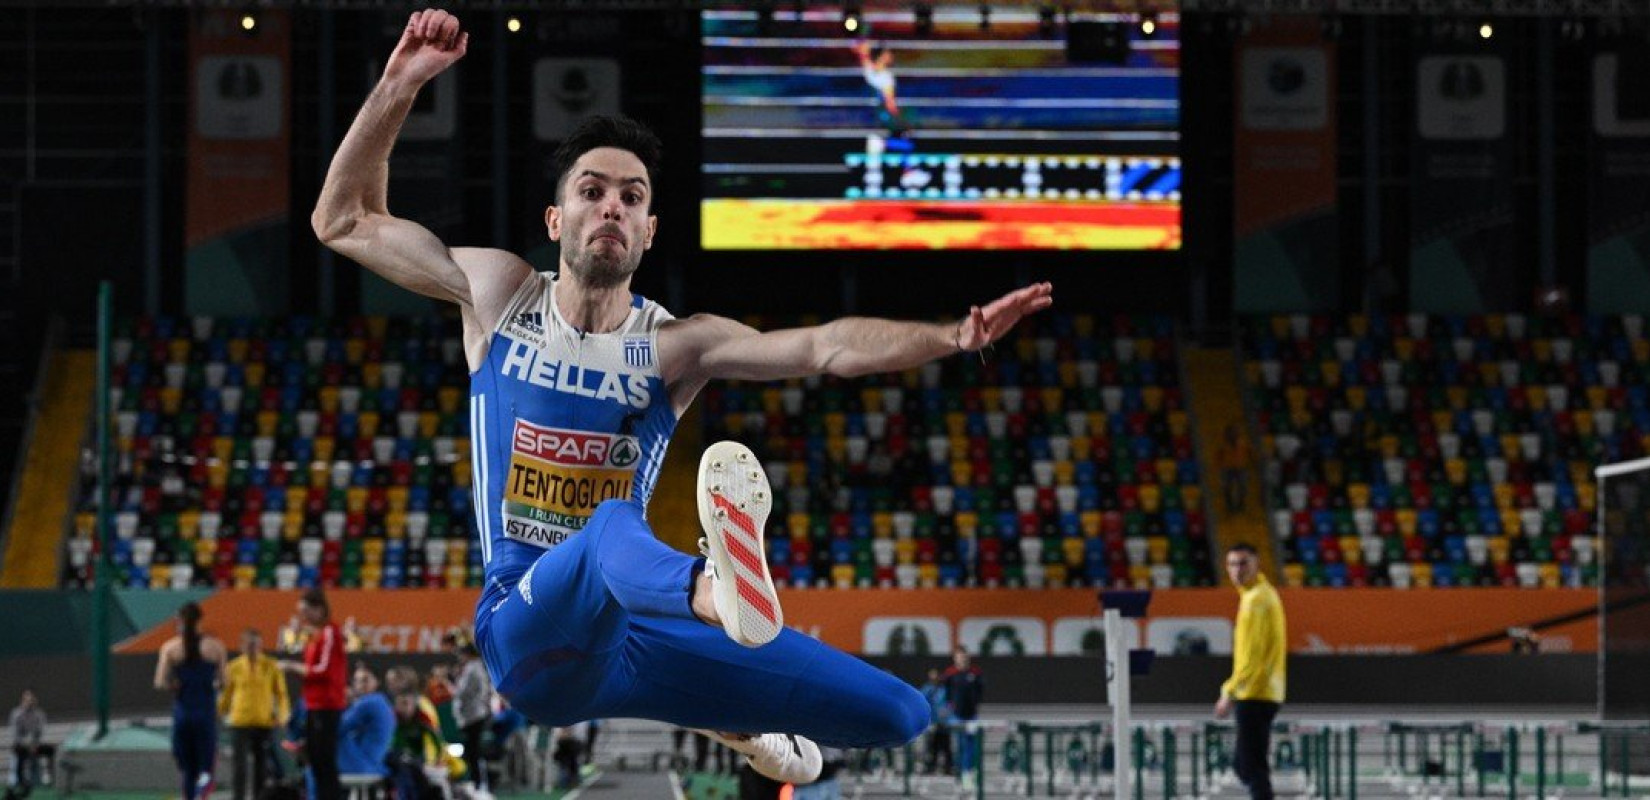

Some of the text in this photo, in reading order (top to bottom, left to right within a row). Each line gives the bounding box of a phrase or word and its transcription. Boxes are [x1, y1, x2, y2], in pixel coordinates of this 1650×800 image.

[501, 339, 651, 409] HELLAS
[516, 427, 607, 461] SPAR
[513, 463, 629, 509] TENTOGLOU
[506, 519, 569, 546] ISTANB
[536, 509, 561, 525] RUN
[564, 516, 591, 528] CLE
